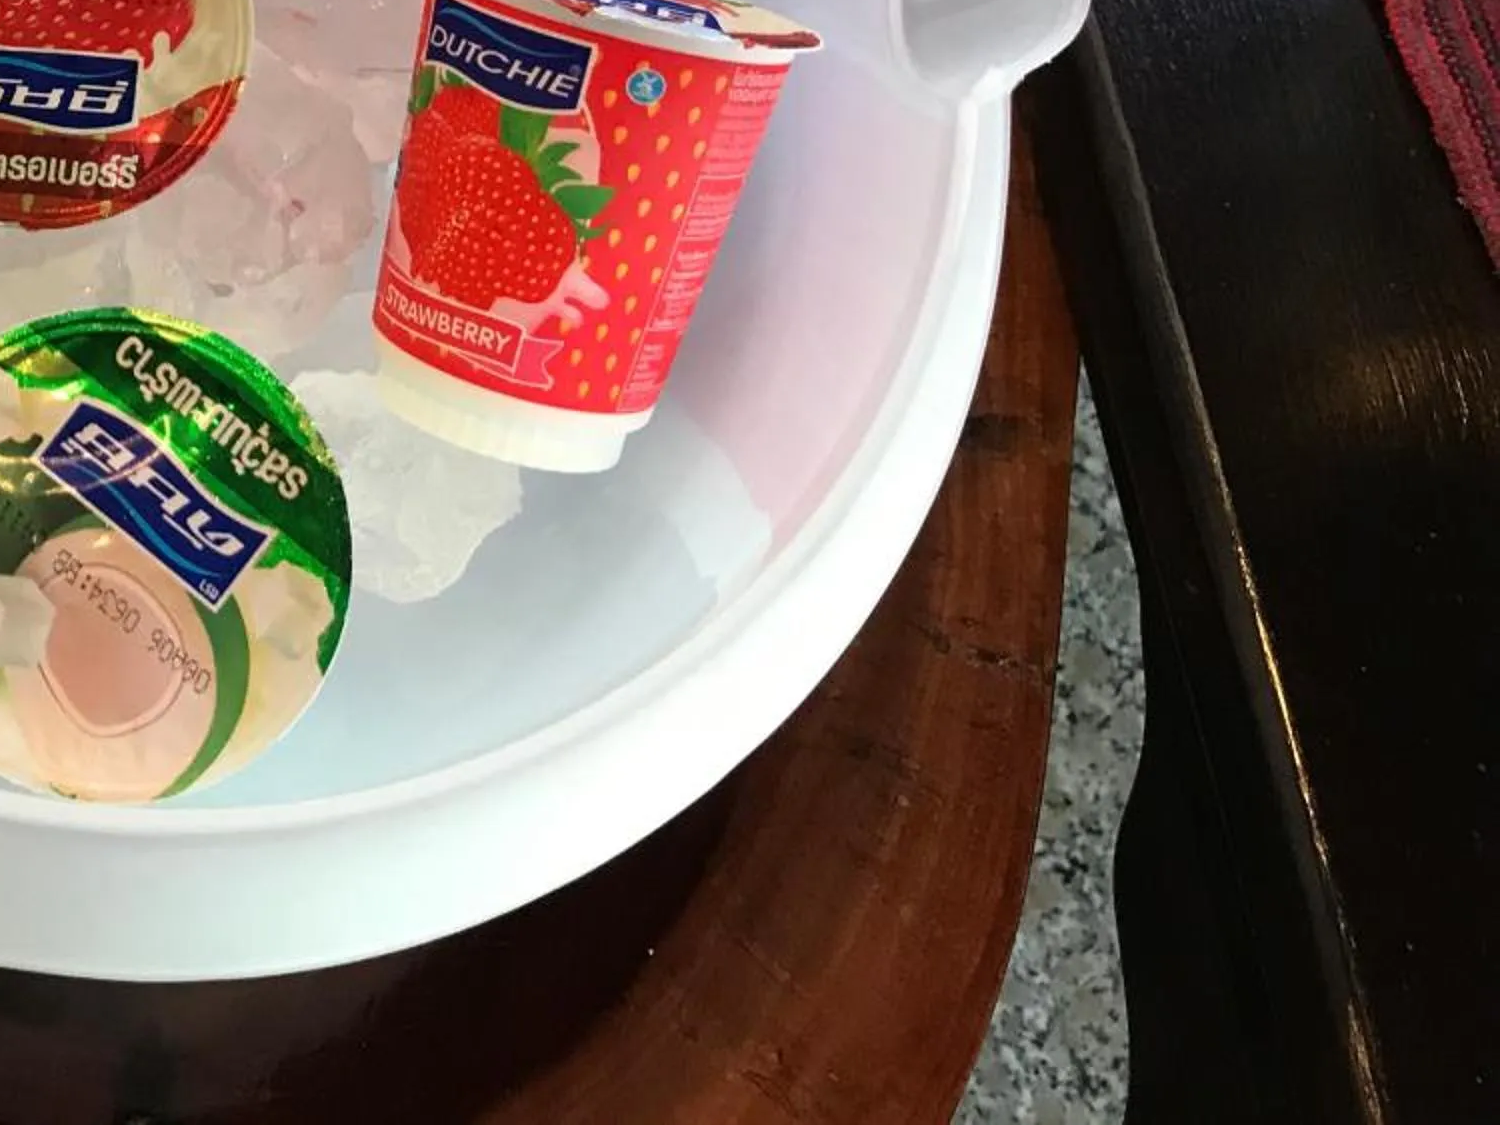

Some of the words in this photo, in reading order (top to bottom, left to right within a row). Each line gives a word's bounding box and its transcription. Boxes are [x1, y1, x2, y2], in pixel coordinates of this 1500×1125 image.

[430, 23, 580, 99] DUTCHIE
[383, 284, 514, 355] STRAWBERRY
[115, 335, 309, 501] รสวุ้นมะพร้าว
